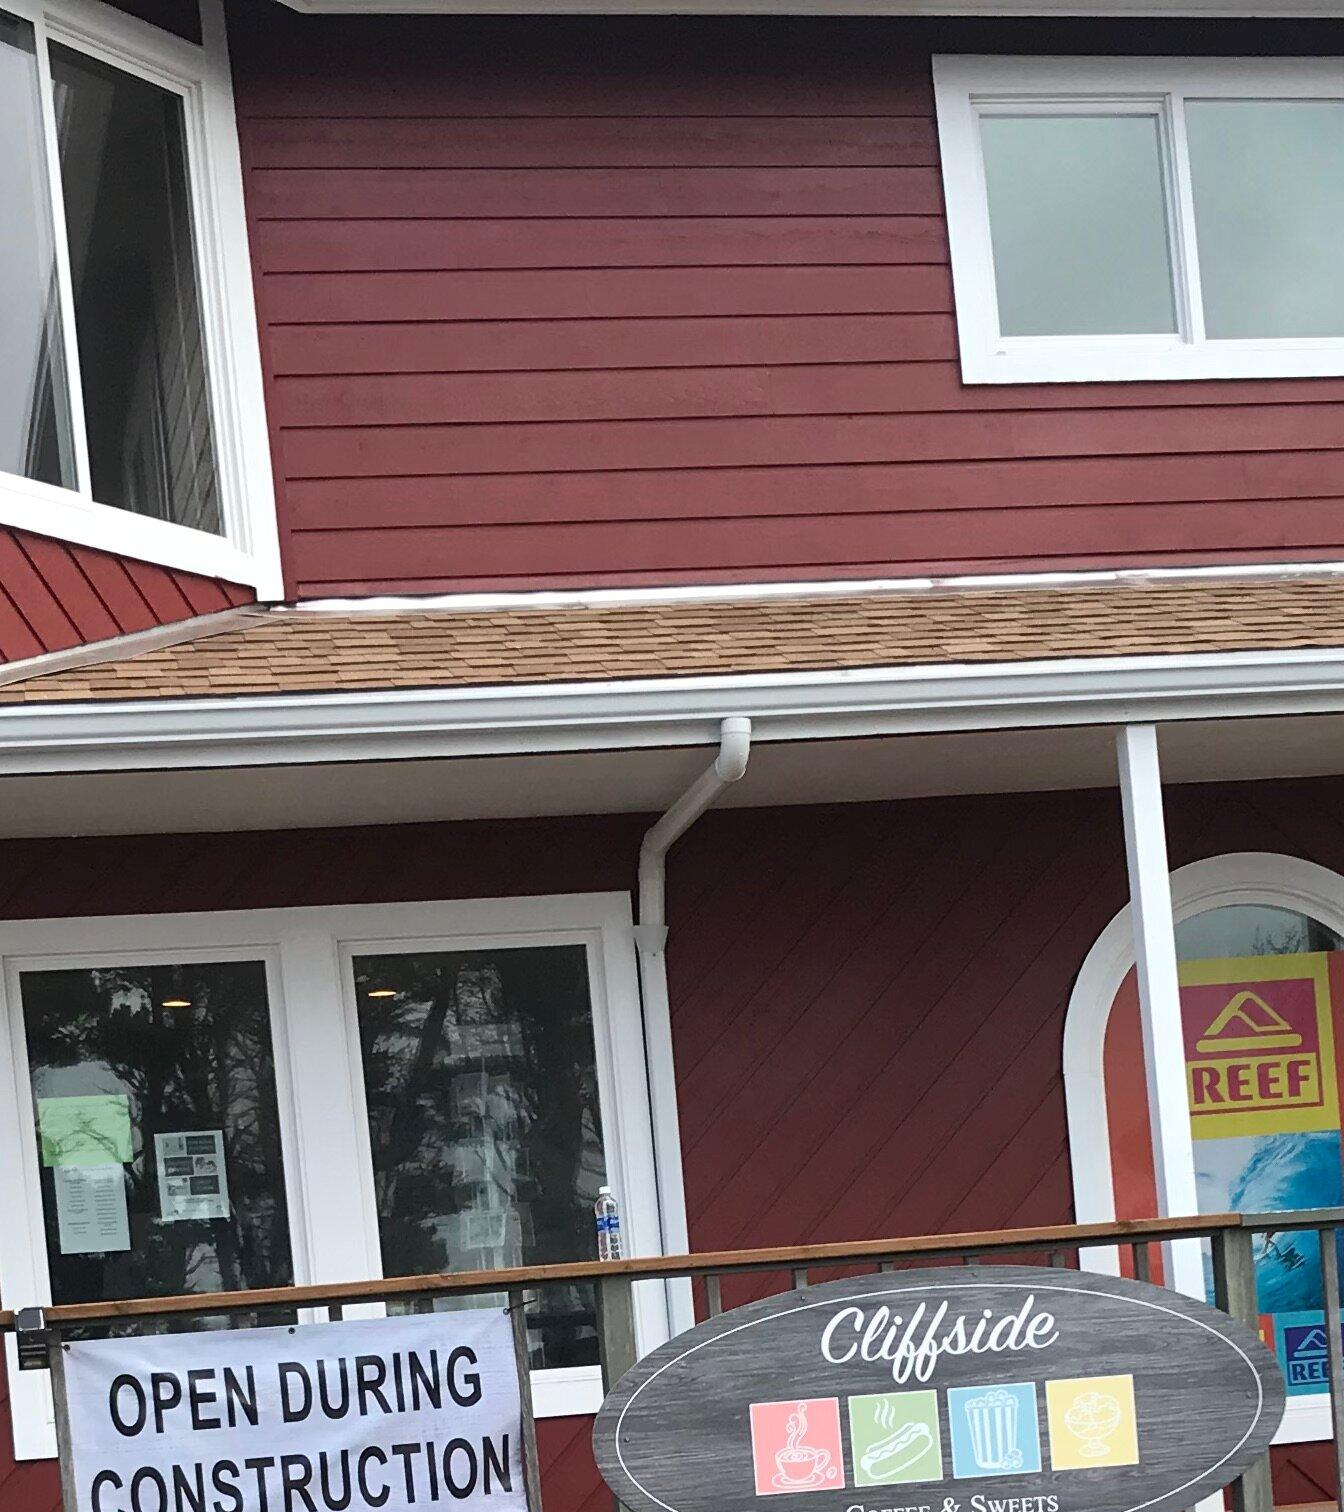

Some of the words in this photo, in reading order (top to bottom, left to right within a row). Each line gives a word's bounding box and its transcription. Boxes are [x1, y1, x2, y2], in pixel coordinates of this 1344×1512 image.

[1192, 1059, 1311, 1105] REEF
[821, 1294, 1060, 1384] Cliffside
[109, 1364, 258, 1438] OPEN
[279, 1345, 483, 1423] DURING
